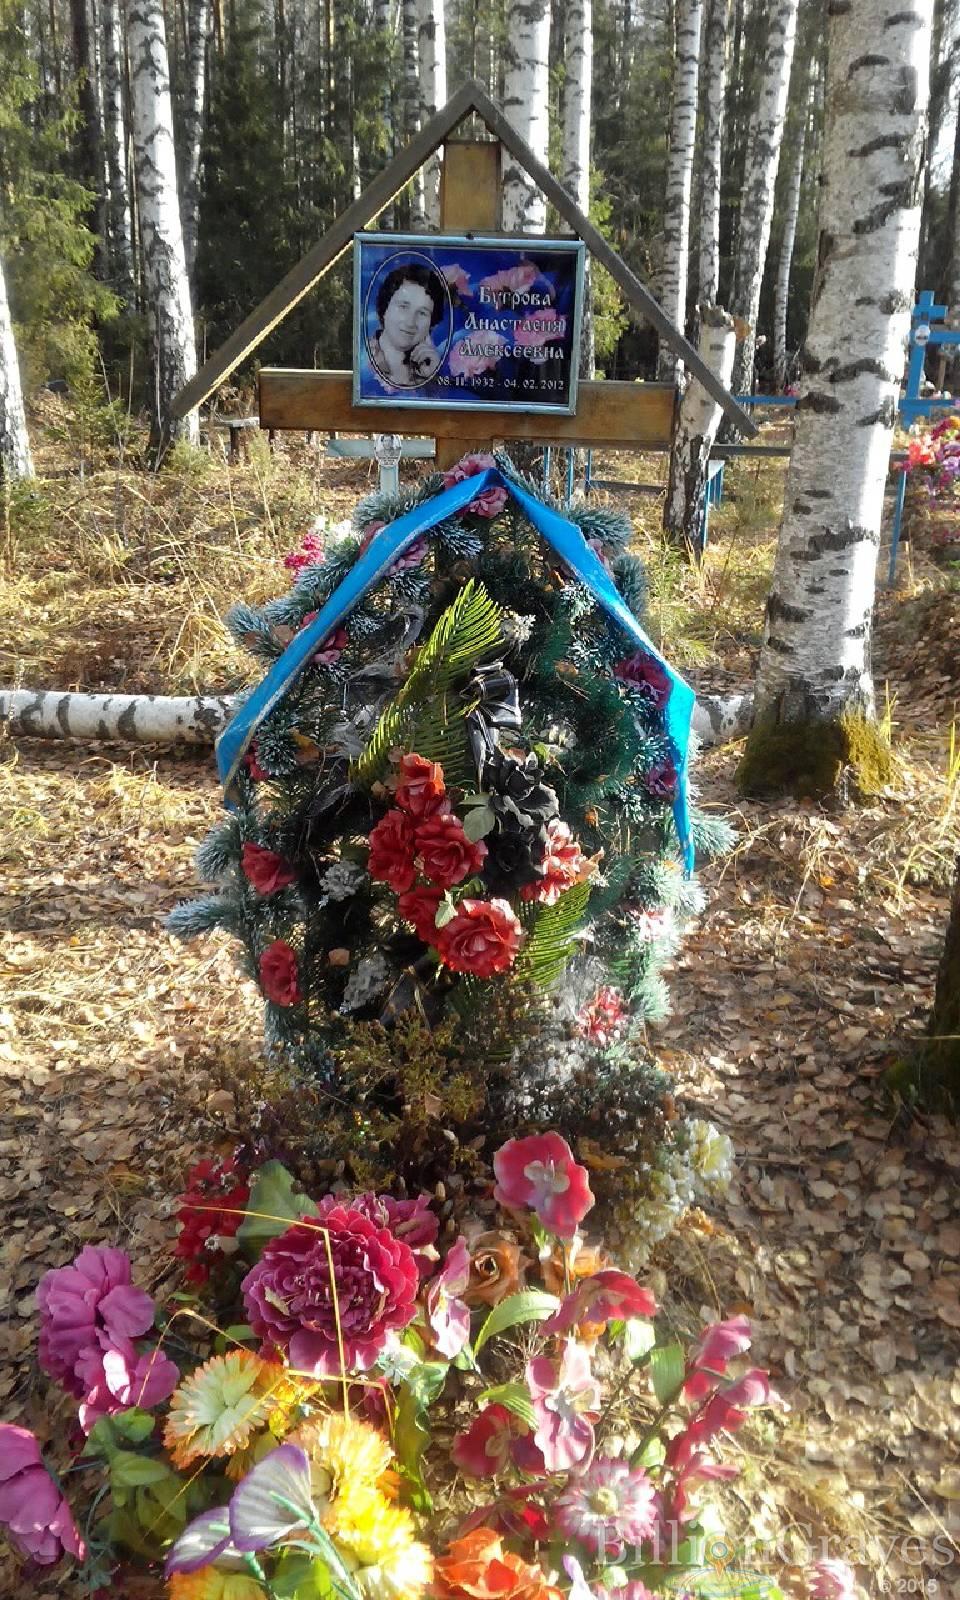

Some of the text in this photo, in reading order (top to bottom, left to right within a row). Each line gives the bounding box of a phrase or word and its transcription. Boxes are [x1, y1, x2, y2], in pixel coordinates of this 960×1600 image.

[479, 286, 552, 310] Бугрова
[464, 312, 567, 333] Анастасия
[459, 339, 565, 359] Алексеевна
